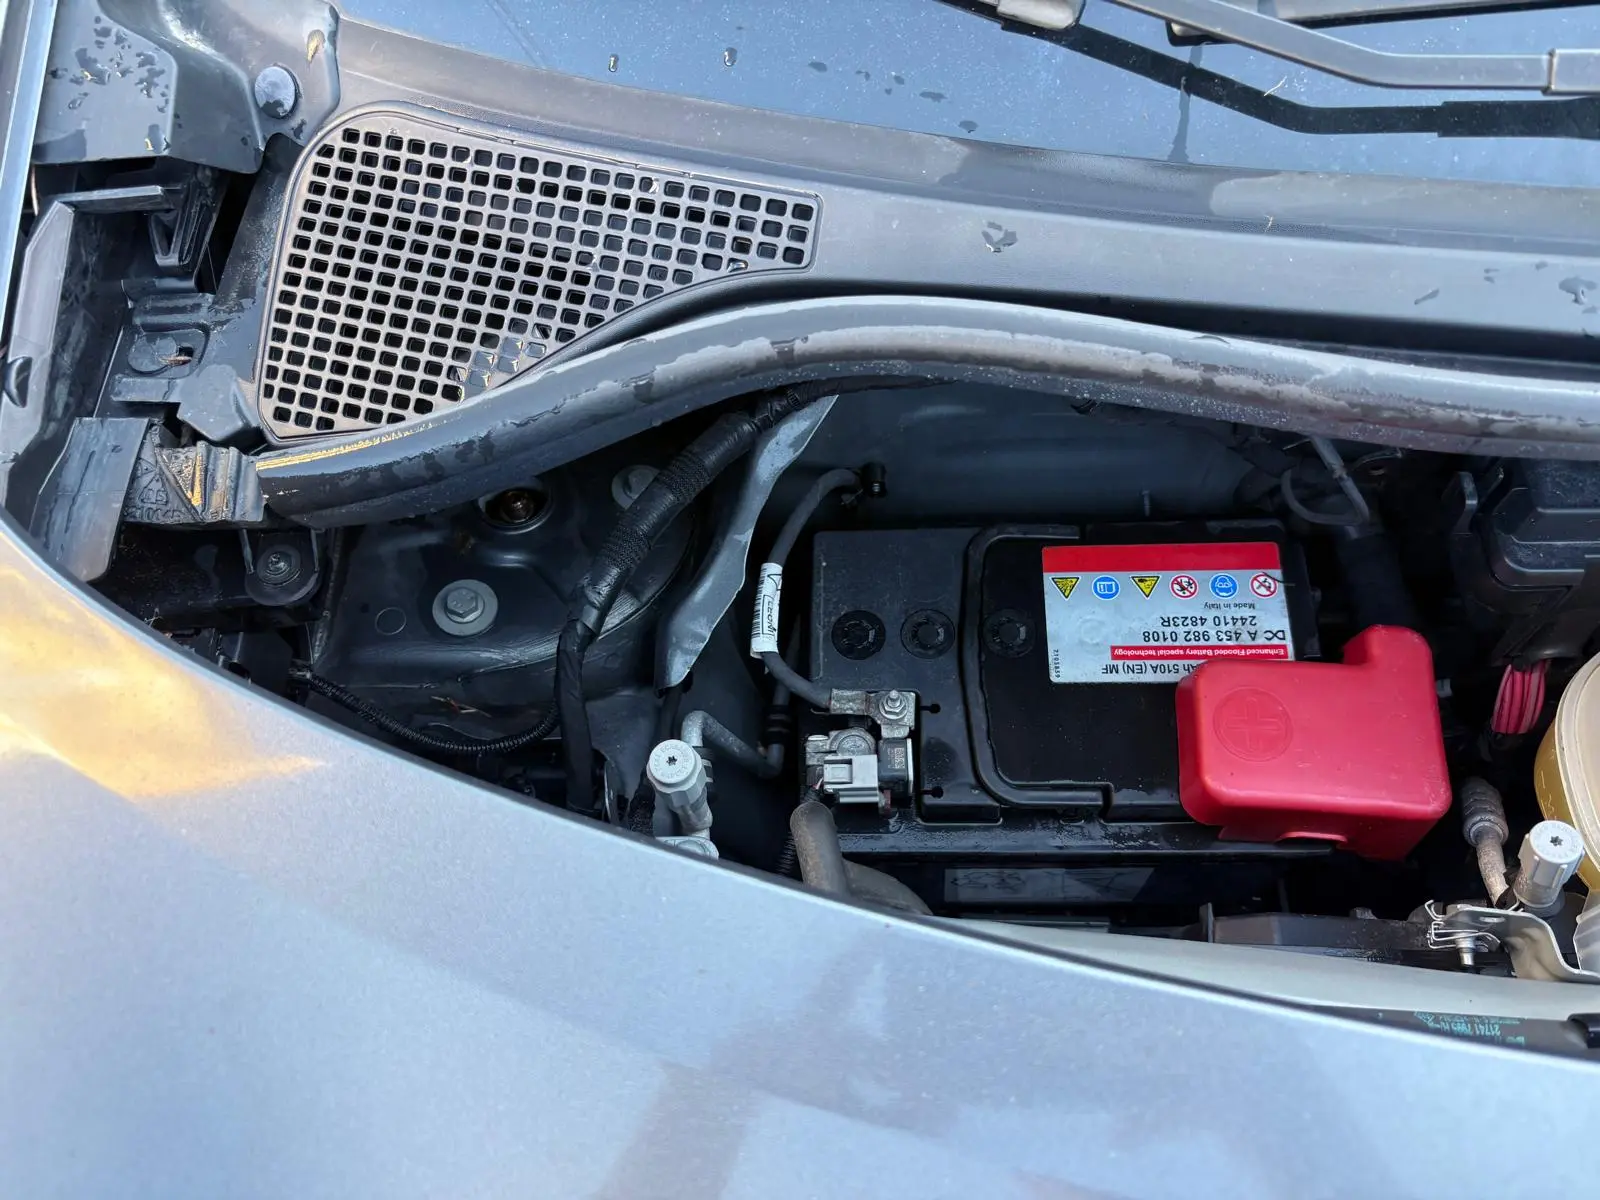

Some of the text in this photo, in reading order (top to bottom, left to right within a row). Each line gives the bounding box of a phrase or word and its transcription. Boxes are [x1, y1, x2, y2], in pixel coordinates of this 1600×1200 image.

[1203, 601, 1255, 612] Made in Italy
[1160, 615, 1257, 628] 24410 4823R
[1142, 630, 1178, 643] 0108
[1183, 630, 1211, 642] 982
[1215, 630, 1242, 642] 453
[1246, 630, 1258, 641] A
[1113, 648, 1284, 657] Enhanced Flooded Battery special technology
[1101, 663, 1119, 675] MF
[1122, 661, 1147, 675] (EN)
[1150, 663, 1180, 675] 510A
